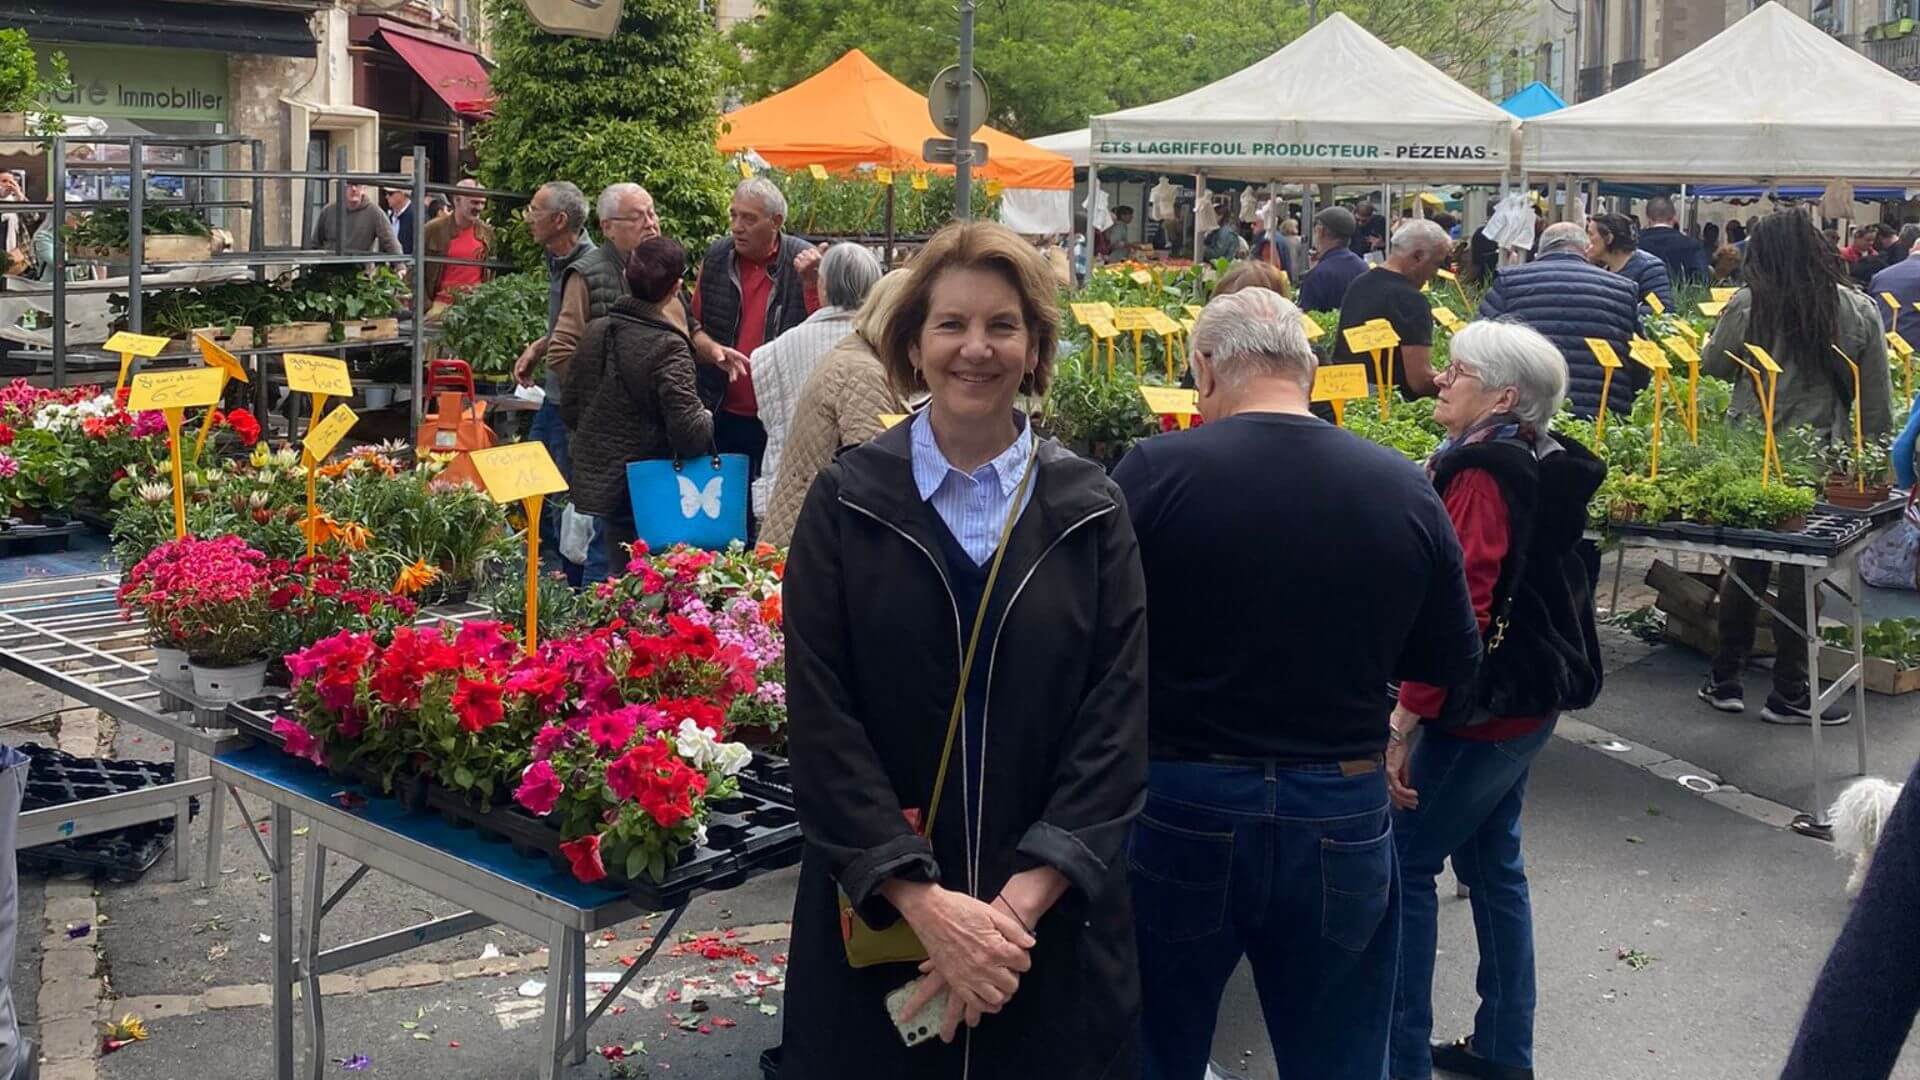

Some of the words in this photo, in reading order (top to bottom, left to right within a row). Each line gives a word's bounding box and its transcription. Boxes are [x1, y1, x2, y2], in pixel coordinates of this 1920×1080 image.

[118, 83, 223, 110] Immobilier
[1100, 141, 1132, 154] ETS
[1137, 142, 1246, 155] LAGRIFFOUL
[1252, 142, 1379, 159] PRODUCTEUR
[1396, 142, 1486, 160] PÉZENAS
